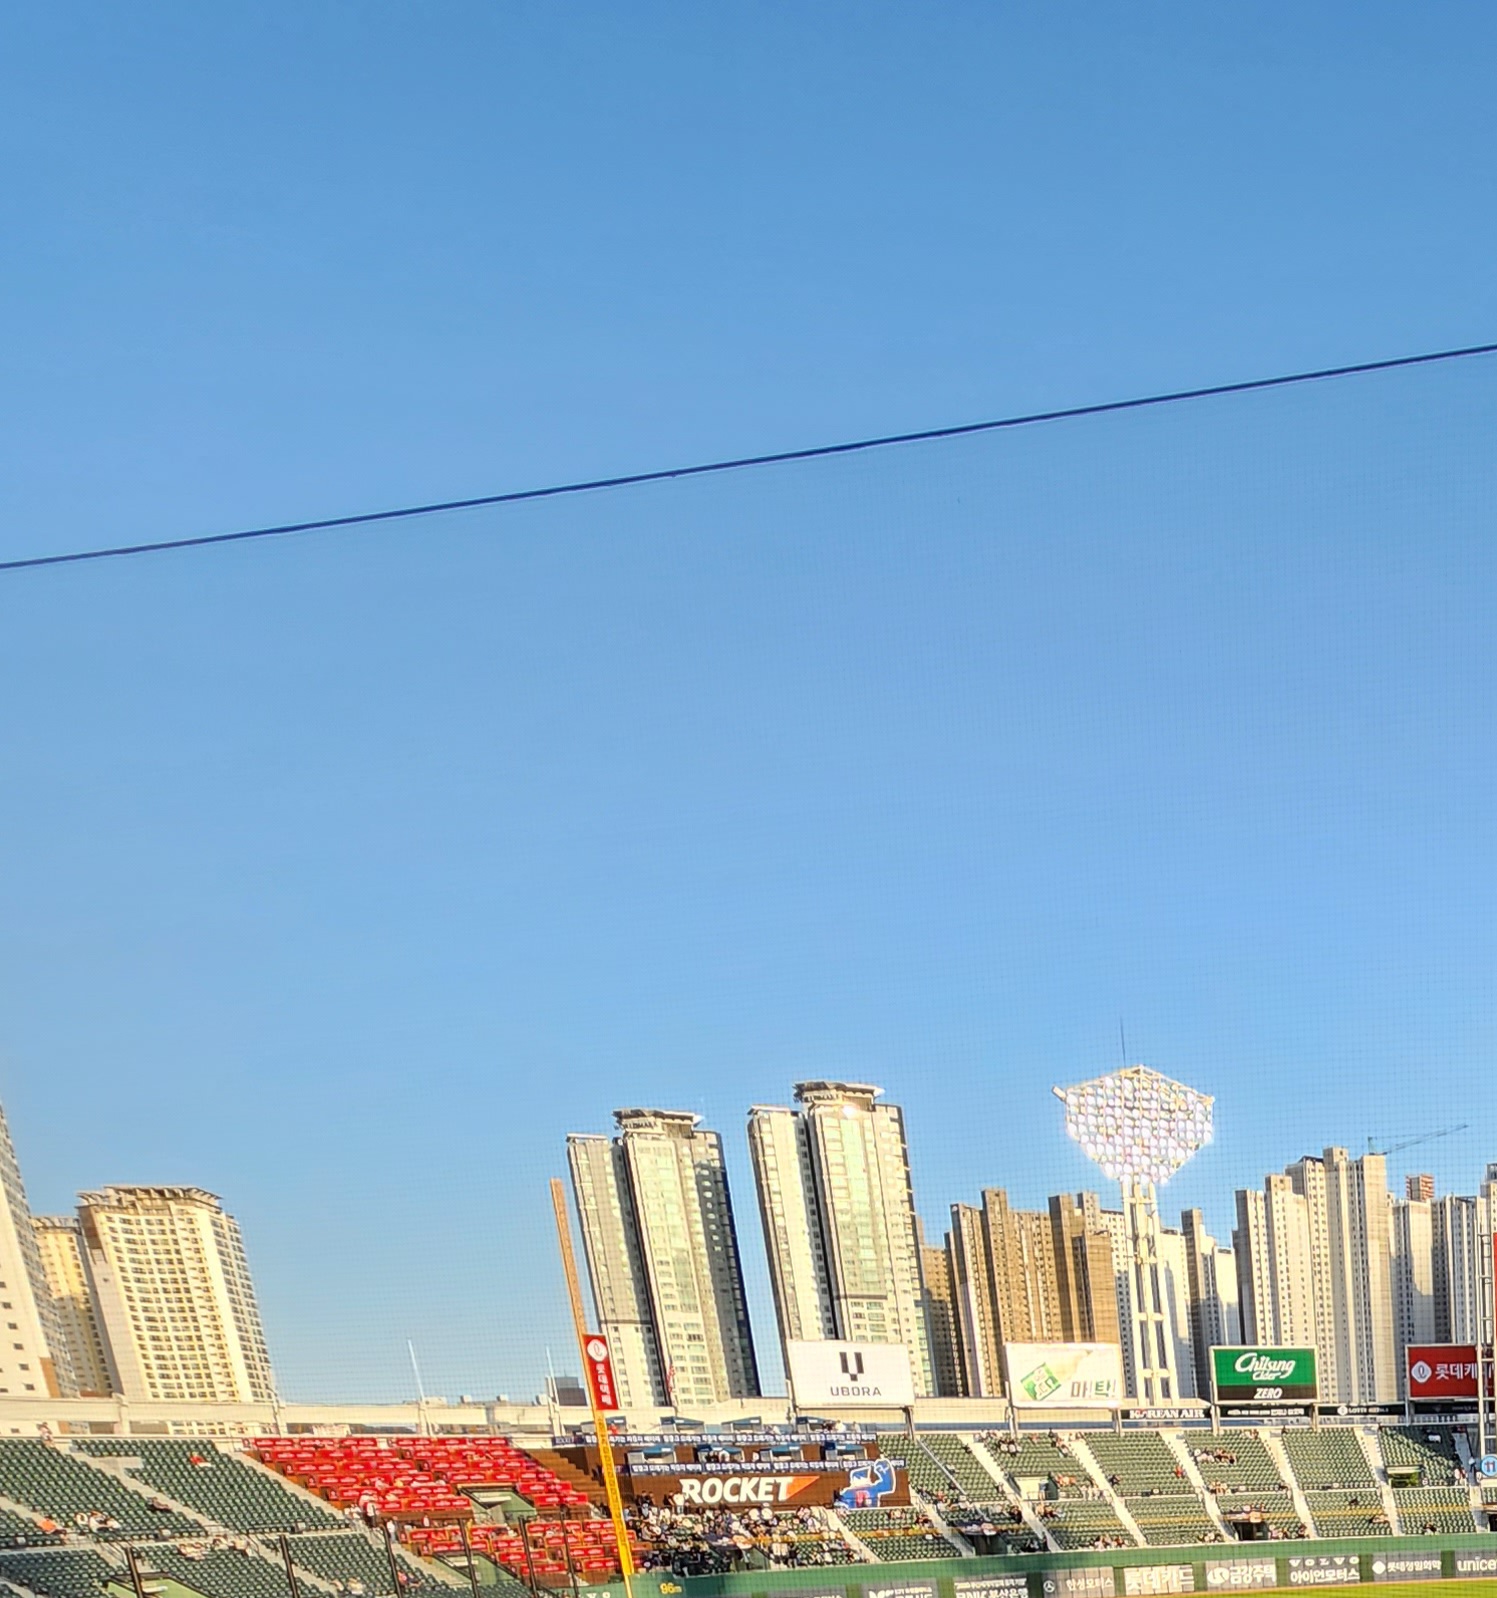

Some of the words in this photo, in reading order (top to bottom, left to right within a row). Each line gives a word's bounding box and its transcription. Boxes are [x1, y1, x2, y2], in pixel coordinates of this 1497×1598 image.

[1234, 1352, 1296, 1378] Chilsung
[1253, 1369, 1281, 1381] Cider
[830, 1386, 882, 1397] UBORA
[1253, 1387, 1283, 1399] ZERO
[1129, 1410, 1178, 1420] KOREAN
[1180, 1409, 1205, 1418] AIR
[1486, 1460, 1495, 1473] 11
[680, 1475, 795, 1504] ROCKET
[1289, 1556, 1359, 1567] VOLVO
[1230, 1564, 1276, 1584] 금강주택
[1290, 1567, 1360, 1583] 아이언모터스
[1066, 1577, 1113, 1591] 한성모터스
